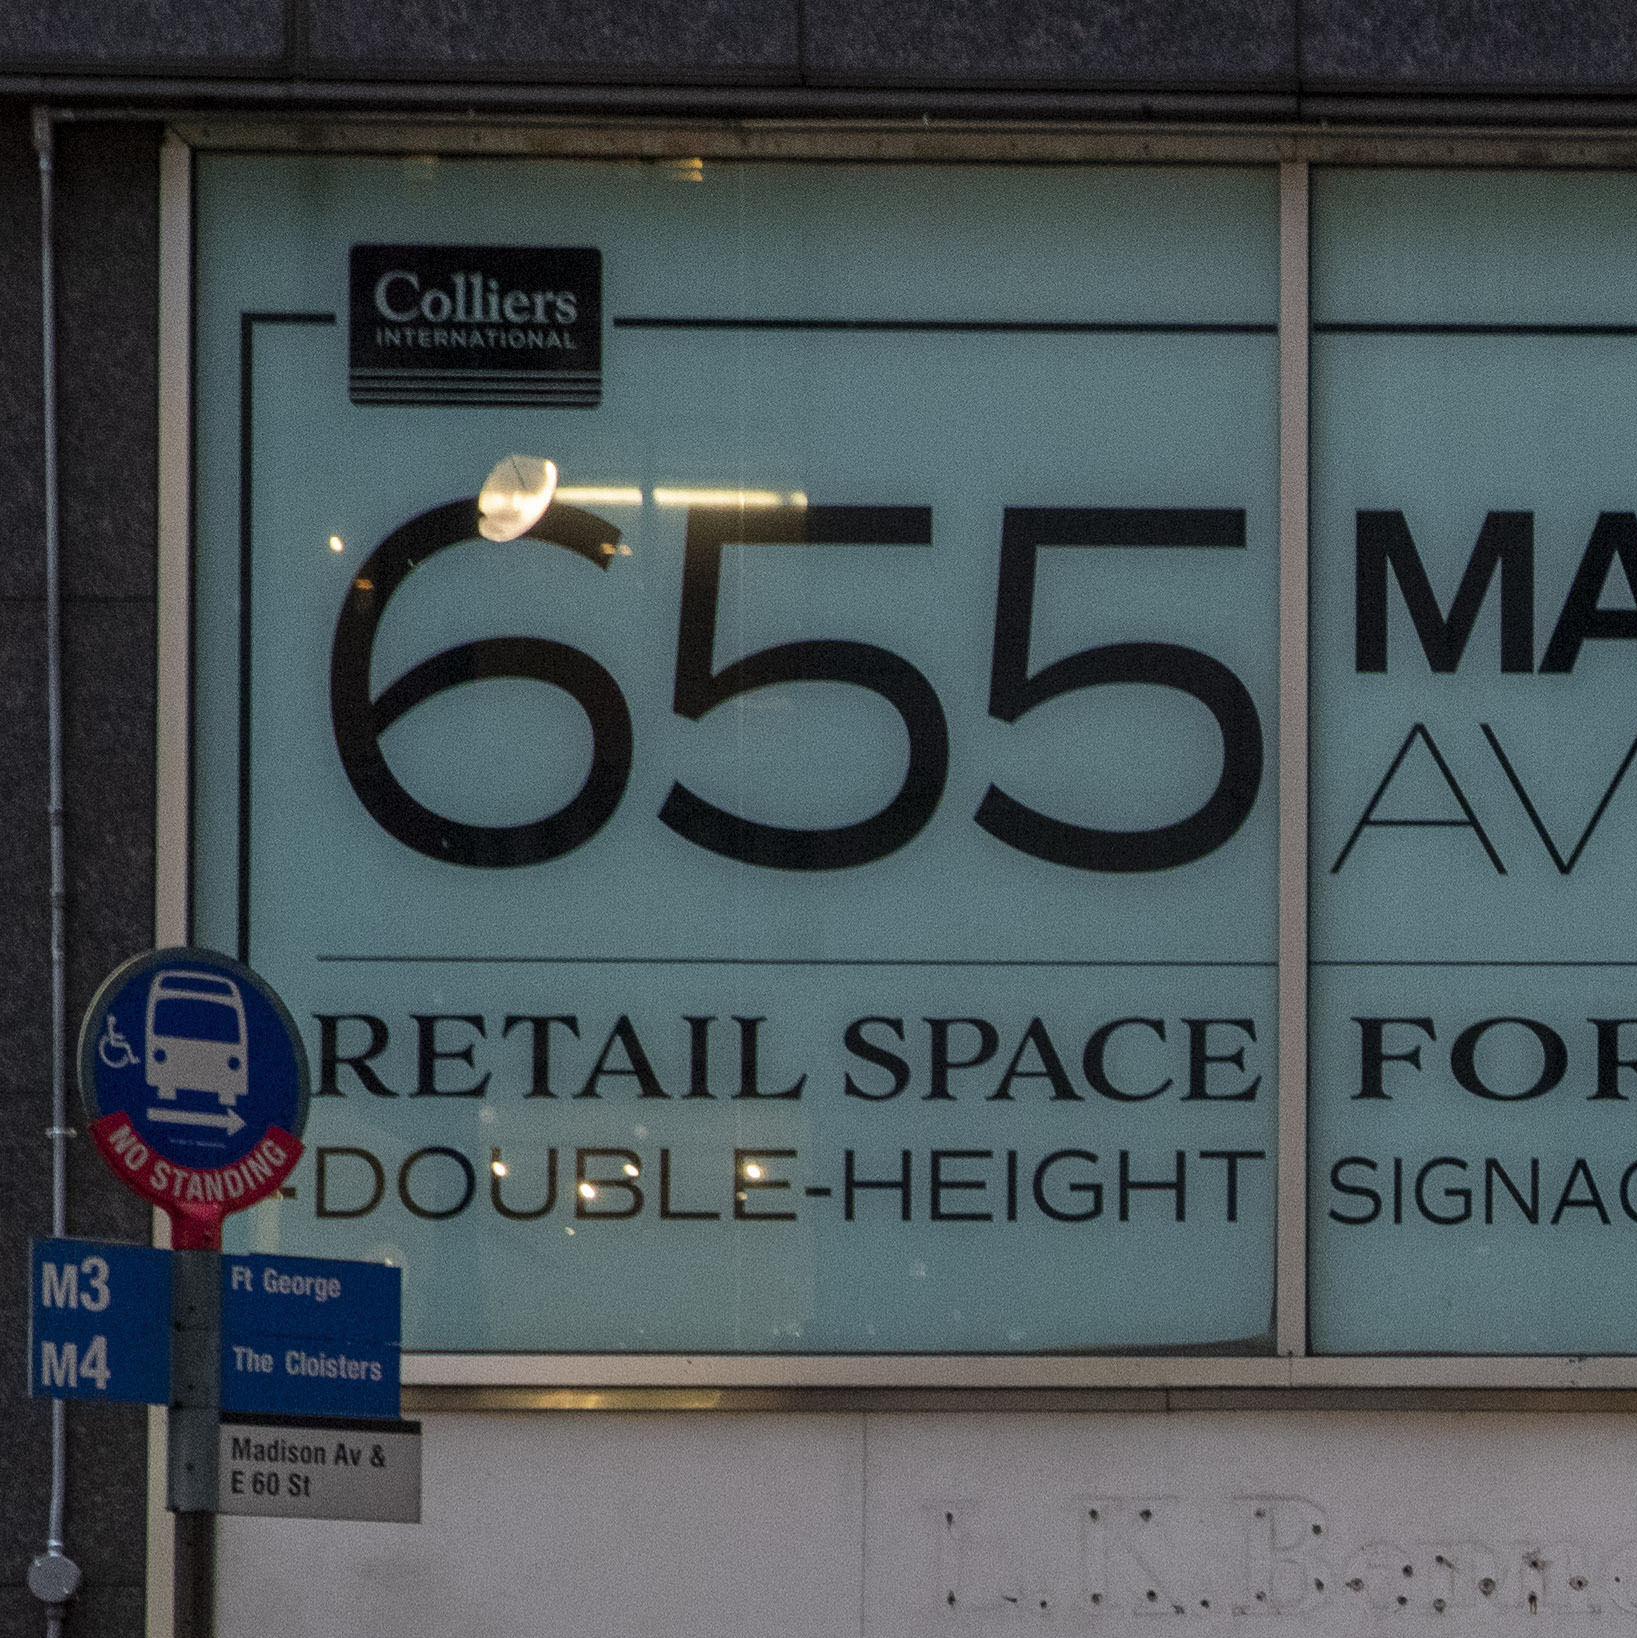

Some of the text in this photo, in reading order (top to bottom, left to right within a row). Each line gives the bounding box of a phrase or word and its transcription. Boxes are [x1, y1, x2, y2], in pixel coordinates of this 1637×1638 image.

[374, 270, 578, 324] Colliers
[375, 327, 577, 349] INTERNATIONAL
[329, 490, 1264, 873] 655
[312, 1012, 809, 1101] RETAIL
[842, 1015, 1264, 1103] SPACE
[107, 1124, 288, 1201] NO STANDING
[315, 1146, 1266, 1222] DOUBLE-HEIGHT
[41, 1256, 111, 1312] M3
[230, 1265, 342, 1302] Ft George
[41, 1335, 111, 1390] M4
[232, 1345, 383, 1381] The Cloisters
[230, 1437, 386, 1468] Madison Av &
[231, 1472, 312, 1497] E 60 St
